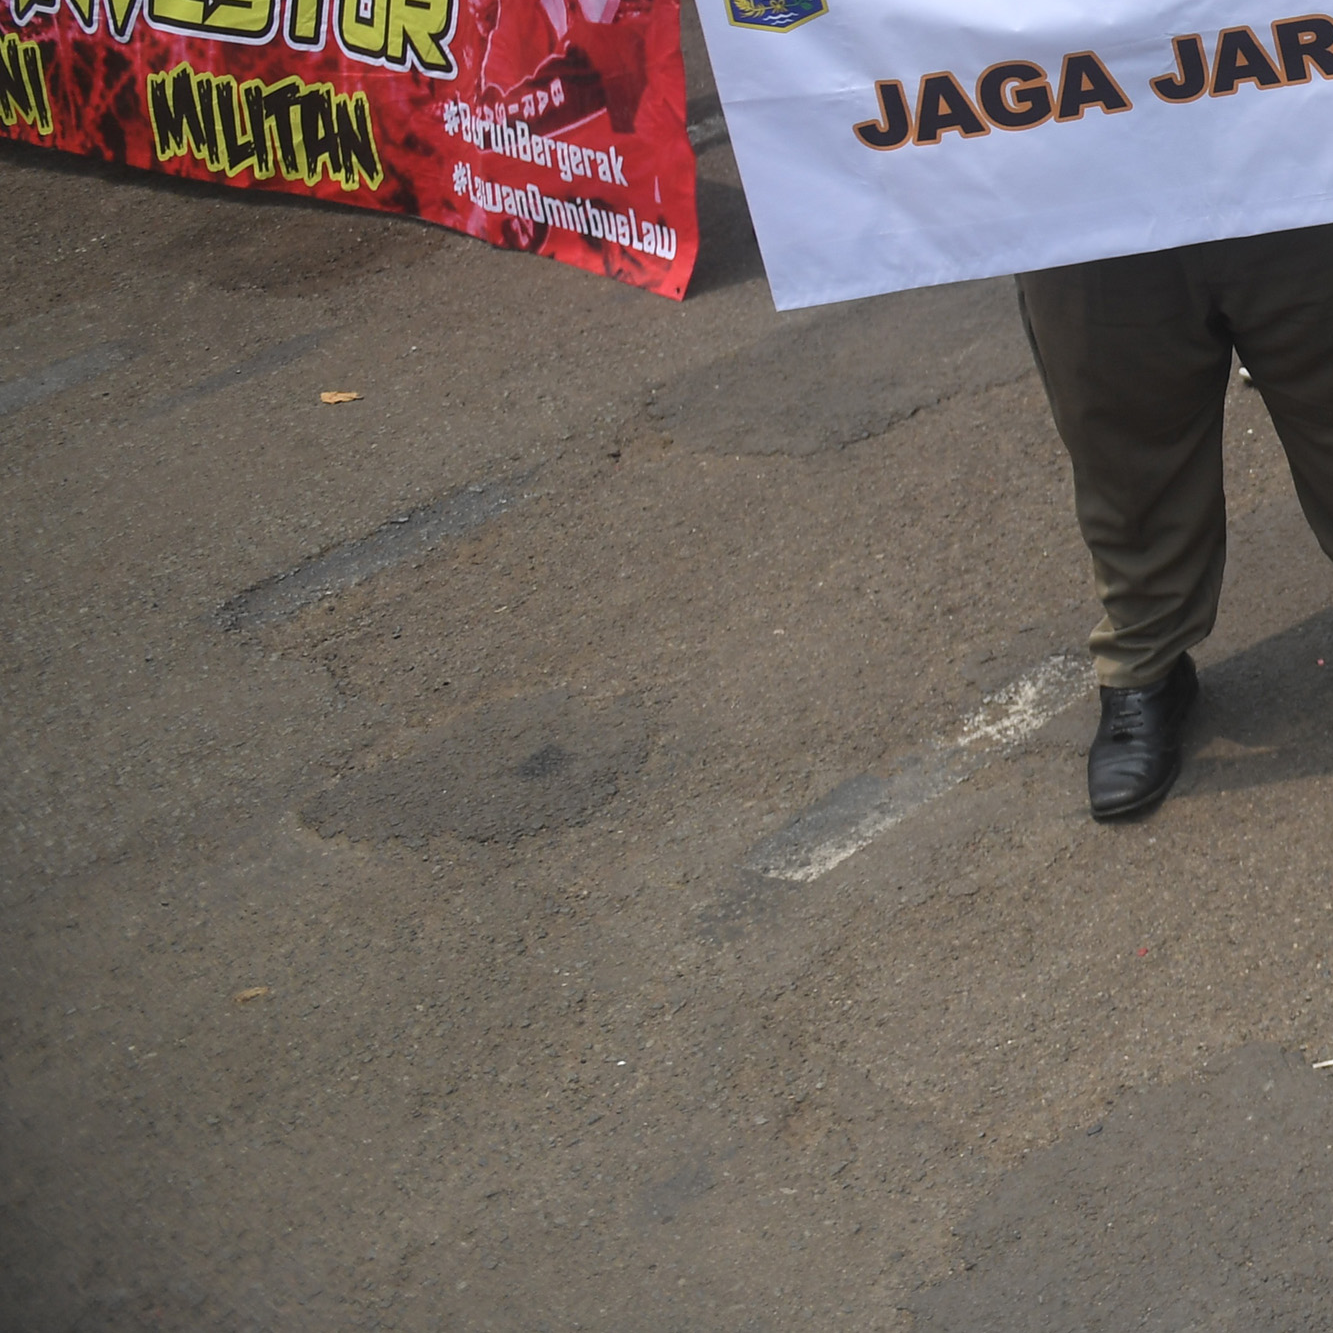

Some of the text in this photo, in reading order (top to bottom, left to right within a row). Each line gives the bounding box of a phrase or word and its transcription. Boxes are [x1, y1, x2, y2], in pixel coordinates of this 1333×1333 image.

[148, 62, 383, 190] MILITAN
[443, 99, 629, 188] #BuruhBergerak
[852, 51, 1132, 151] JAGA
[452, 160, 677, 261] #LawanOmnibusLaw
